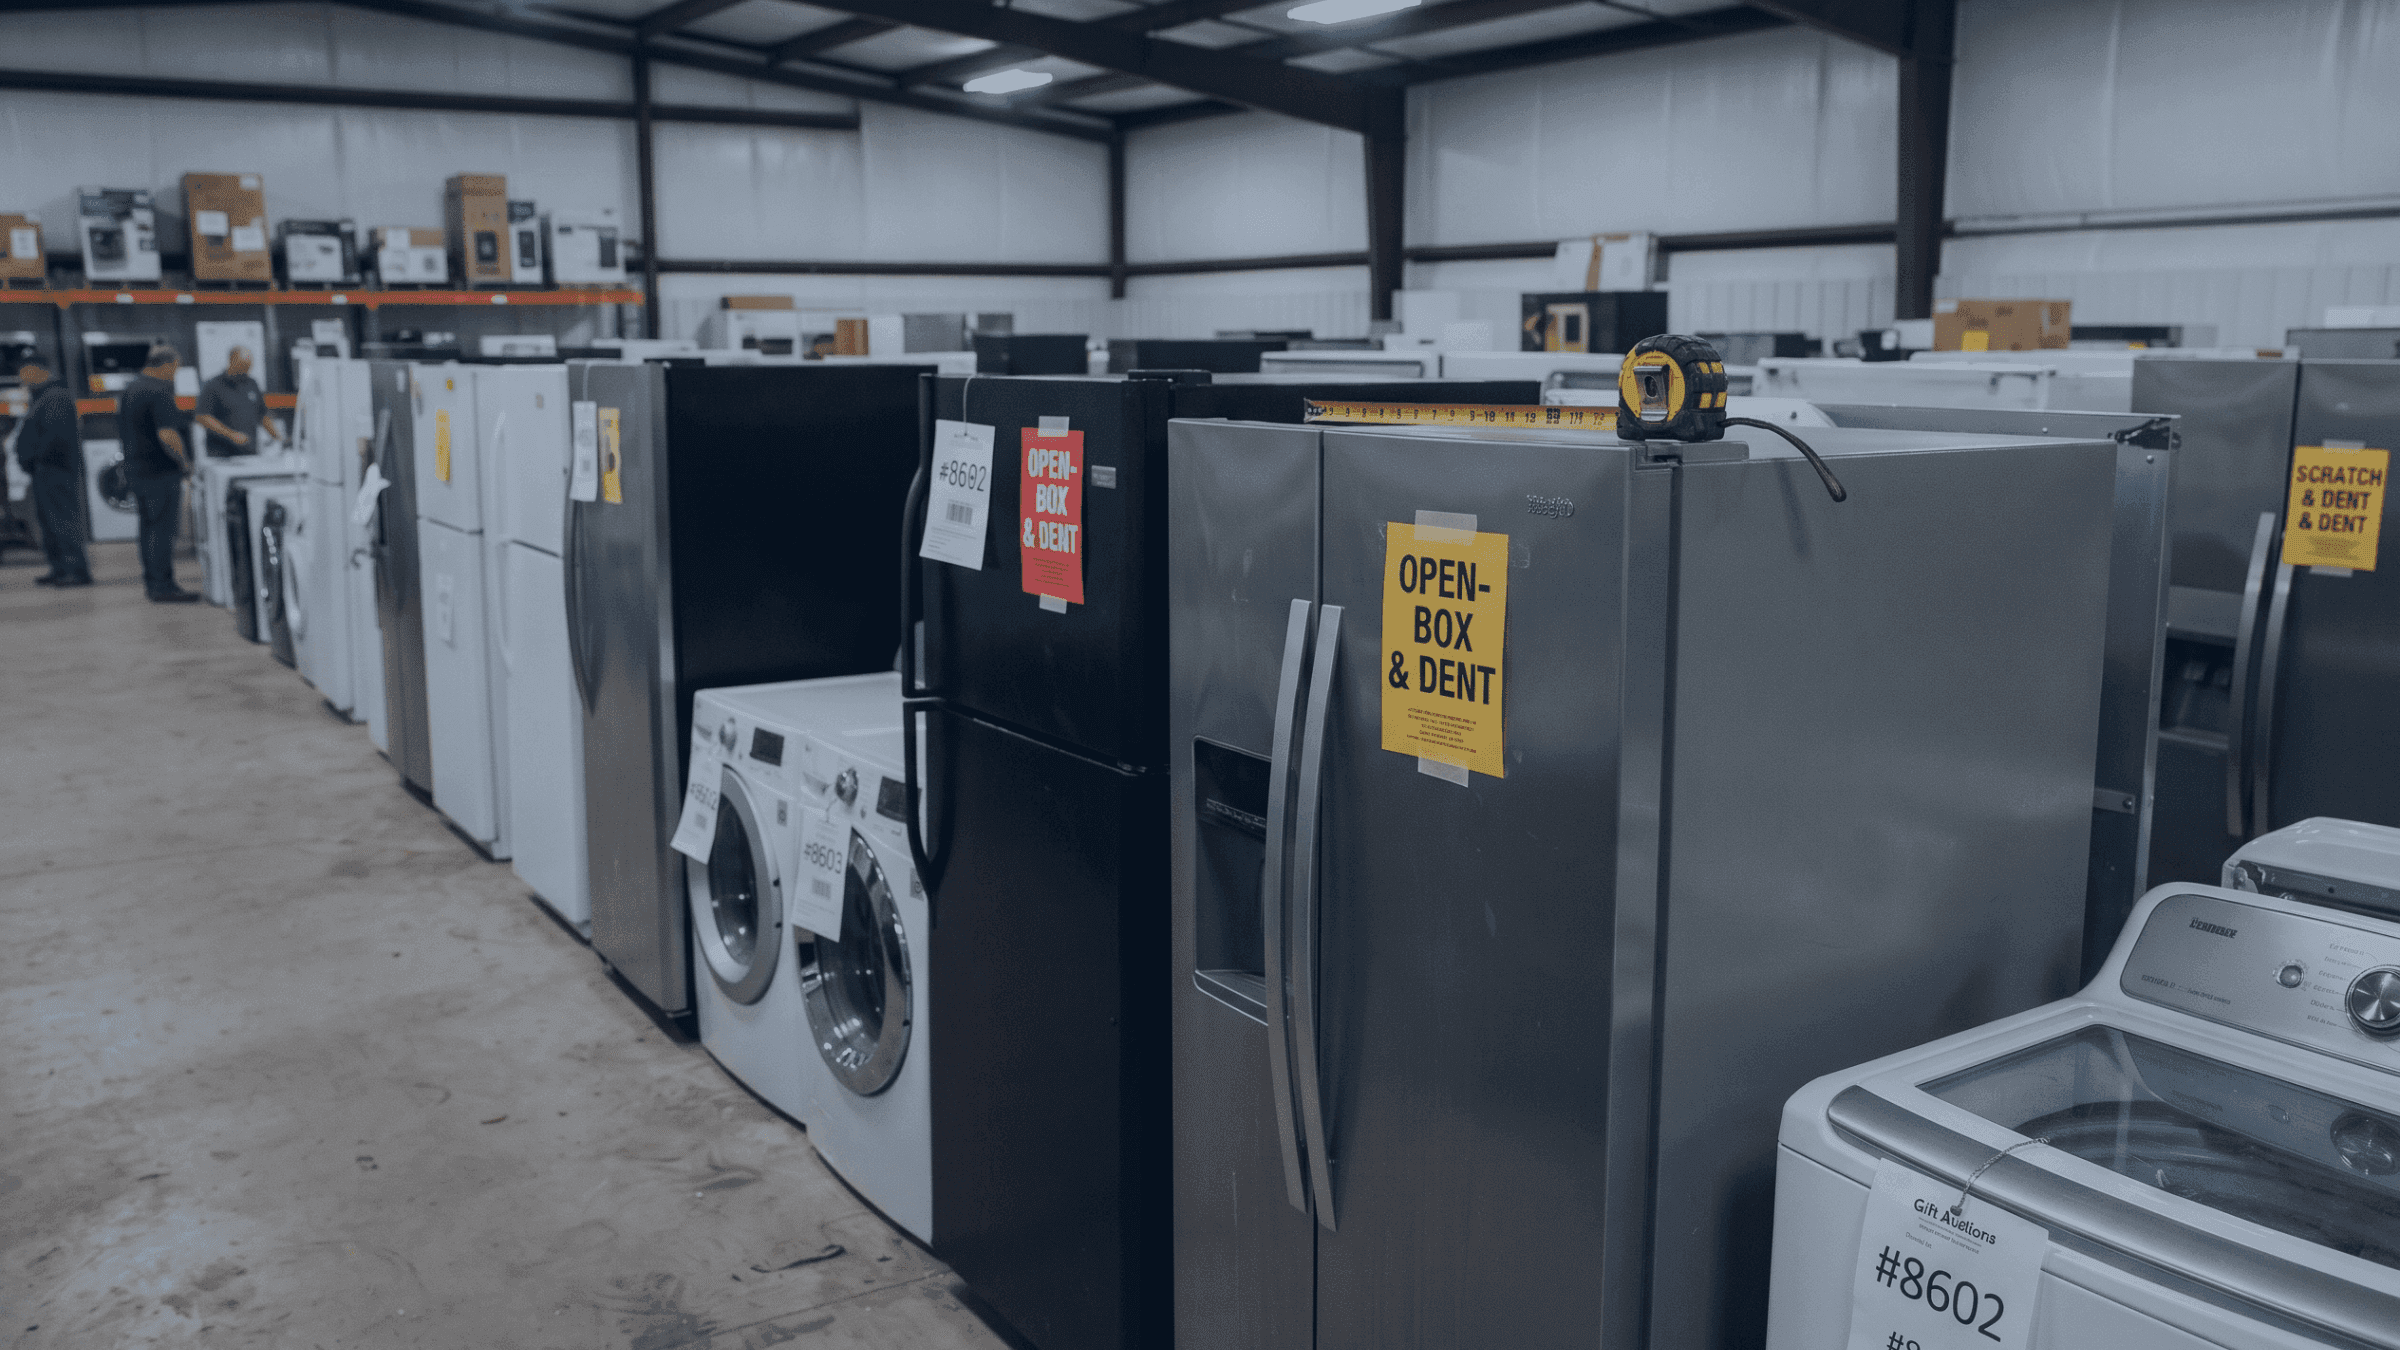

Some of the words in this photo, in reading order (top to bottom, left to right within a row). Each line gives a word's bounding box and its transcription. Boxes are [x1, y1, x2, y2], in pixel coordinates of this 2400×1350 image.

[939, 459, 988, 492] #8602
[1027, 448, 1078, 481] OPEN-
[2296, 465, 2383, 486] SCRATCH
[1035, 483, 1069, 516] BOX
[2302, 489, 2315, 507] &
[2322, 489, 2371, 510] DENT
[1022, 517, 1036, 548] &
[1038, 520, 1079, 554] DENT
[2298, 511, 2312, 530] &
[2318, 513, 2368, 533] DENT
[1399, 554, 1491, 602] OPEN-
[1414, 605, 1474, 652] BOX
[1388, 650, 1410, 690] &
[1419, 655, 1496, 705] DENT
[804, 842, 843, 875] #8603
[1913, 1198, 1939, 1220] Gift
[1875, 1245, 2005, 1343] #8602
